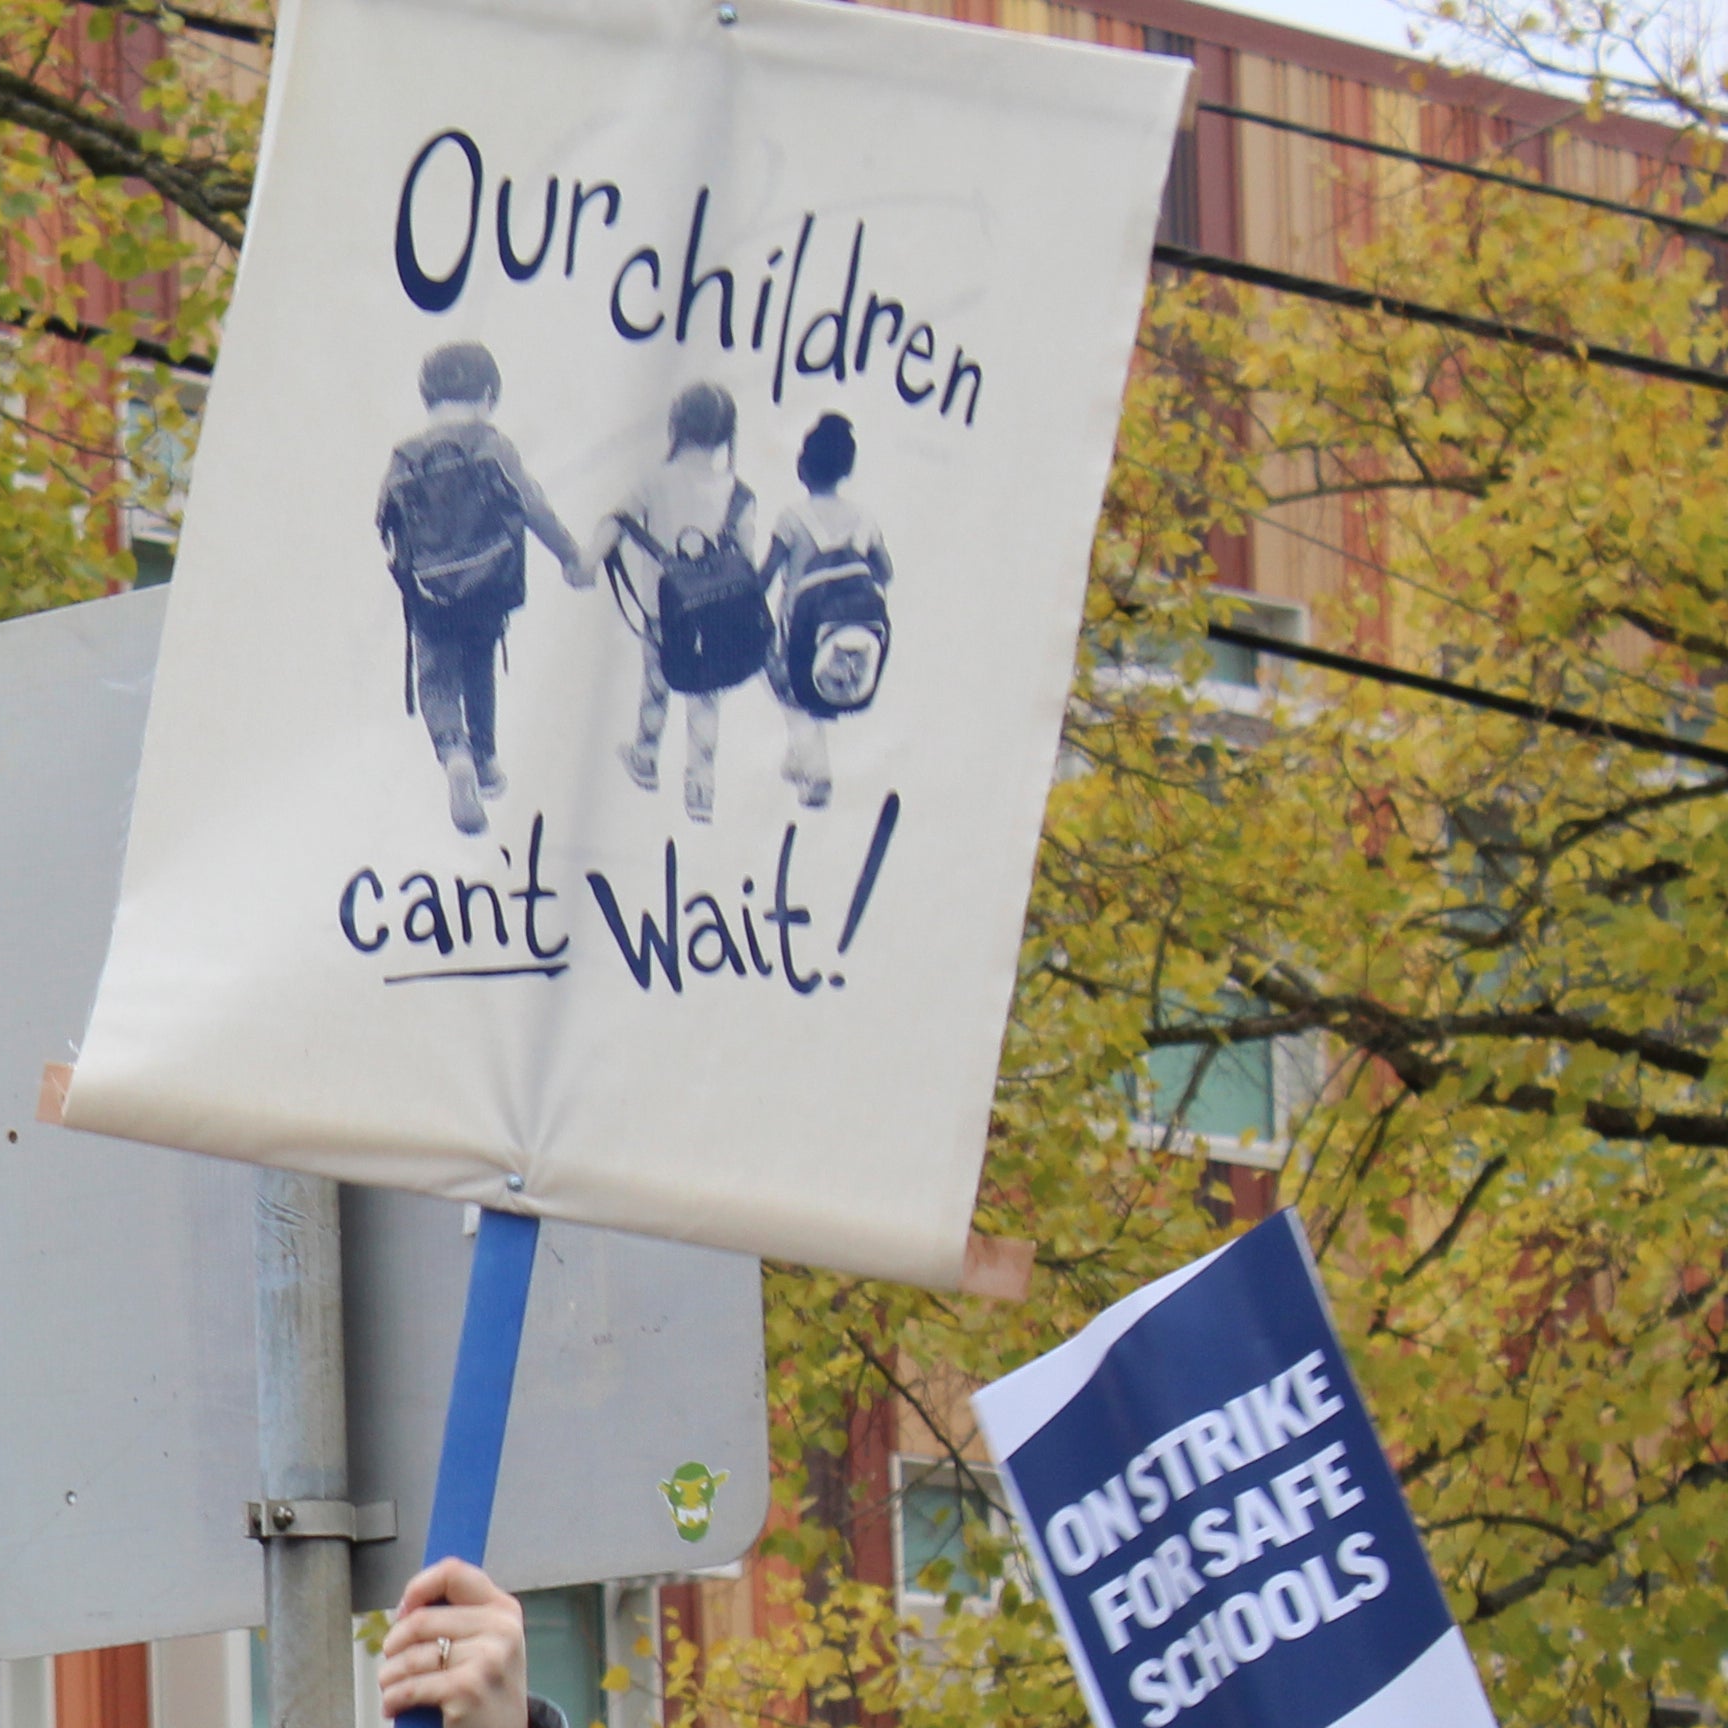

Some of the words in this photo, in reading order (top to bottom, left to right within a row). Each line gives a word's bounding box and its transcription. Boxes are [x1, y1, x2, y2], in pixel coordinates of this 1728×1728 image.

[395, 128, 621, 313] Our
[610, 186, 982, 427] children
[339, 812, 570, 958] can't
[1045, 1474, 1141, 1578] ON
[1126, 1347, 1344, 1524] STRIKE
[1090, 1532, 1206, 1655] FOR
[1189, 1441, 1365, 1579] SAFE
[1129, 1531, 1391, 1728] SCHOOLS
